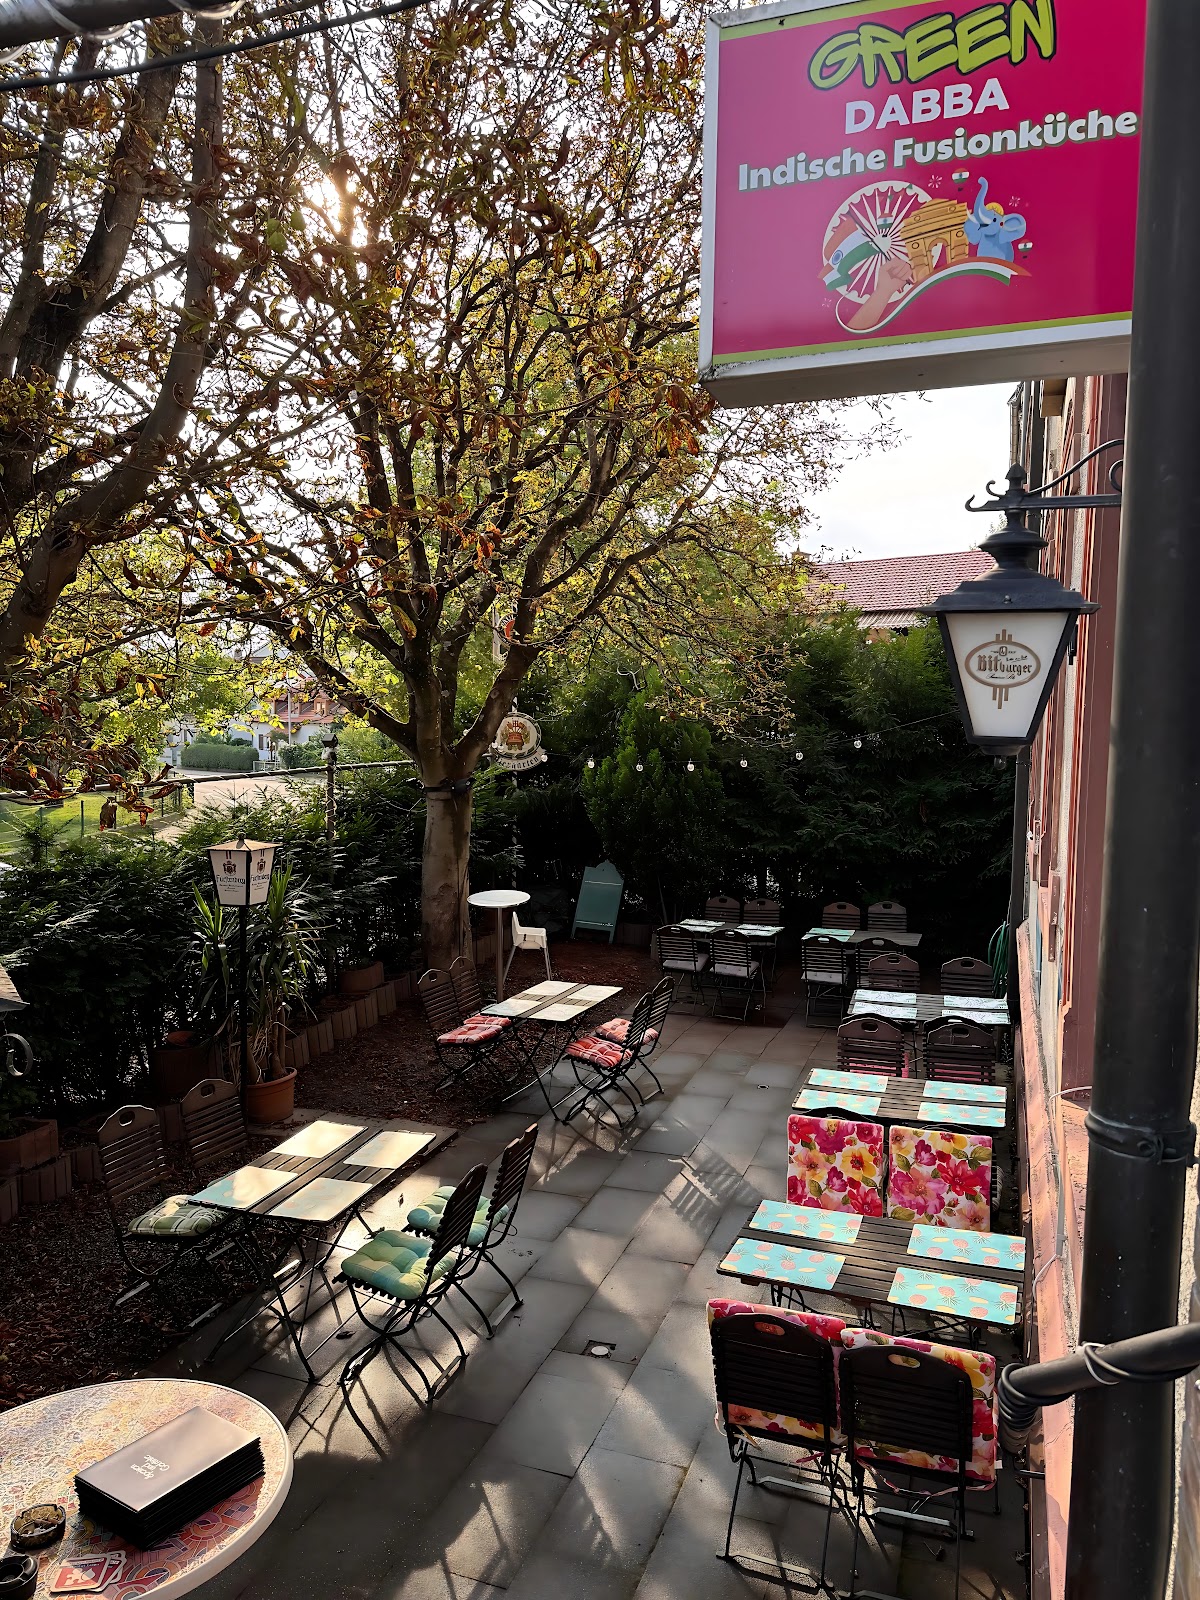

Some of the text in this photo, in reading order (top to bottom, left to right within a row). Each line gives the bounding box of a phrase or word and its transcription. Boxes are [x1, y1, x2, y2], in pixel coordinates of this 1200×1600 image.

[809, 0, 1056, 89] GREEN
[844, 77, 1010, 135] DABBA
[738, 109, 1138, 192] Indische Fusionküche
[978, 655, 1032, 676] Bitburger
